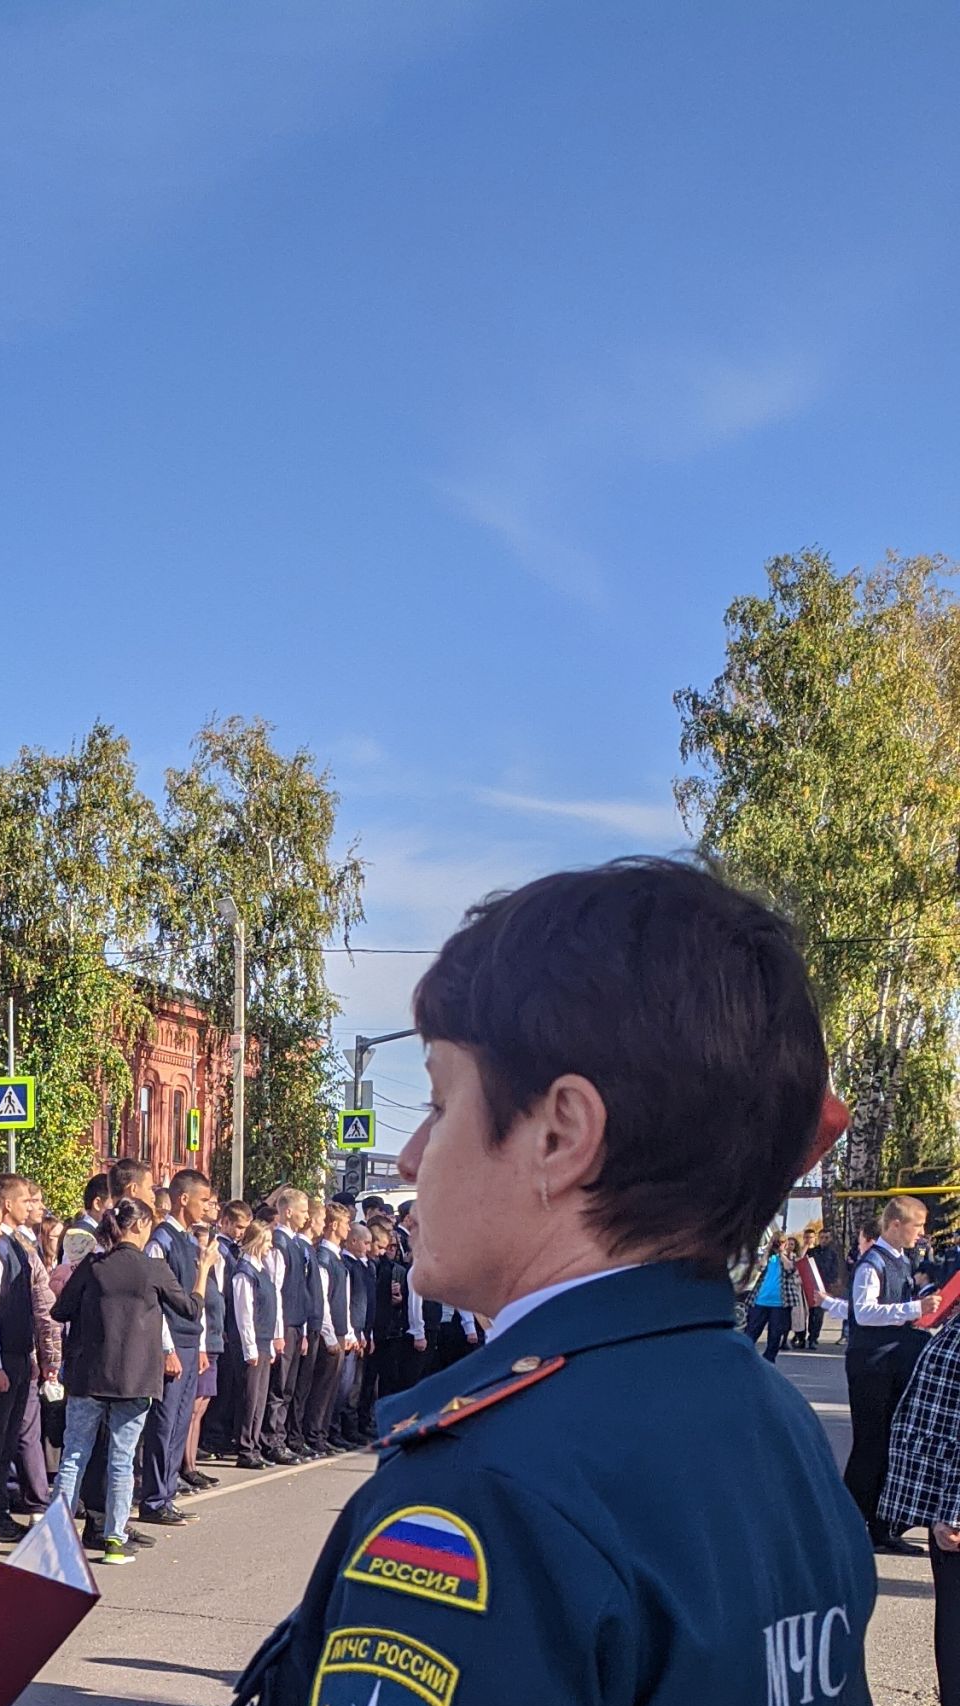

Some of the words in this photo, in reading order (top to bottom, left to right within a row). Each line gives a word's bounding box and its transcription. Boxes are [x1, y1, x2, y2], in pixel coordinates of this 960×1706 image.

[368, 1557, 461, 1595] РОССИЯ
[331, 1638, 371, 1662] МЧС
[374, 1641, 449, 1695] РОССИИ
